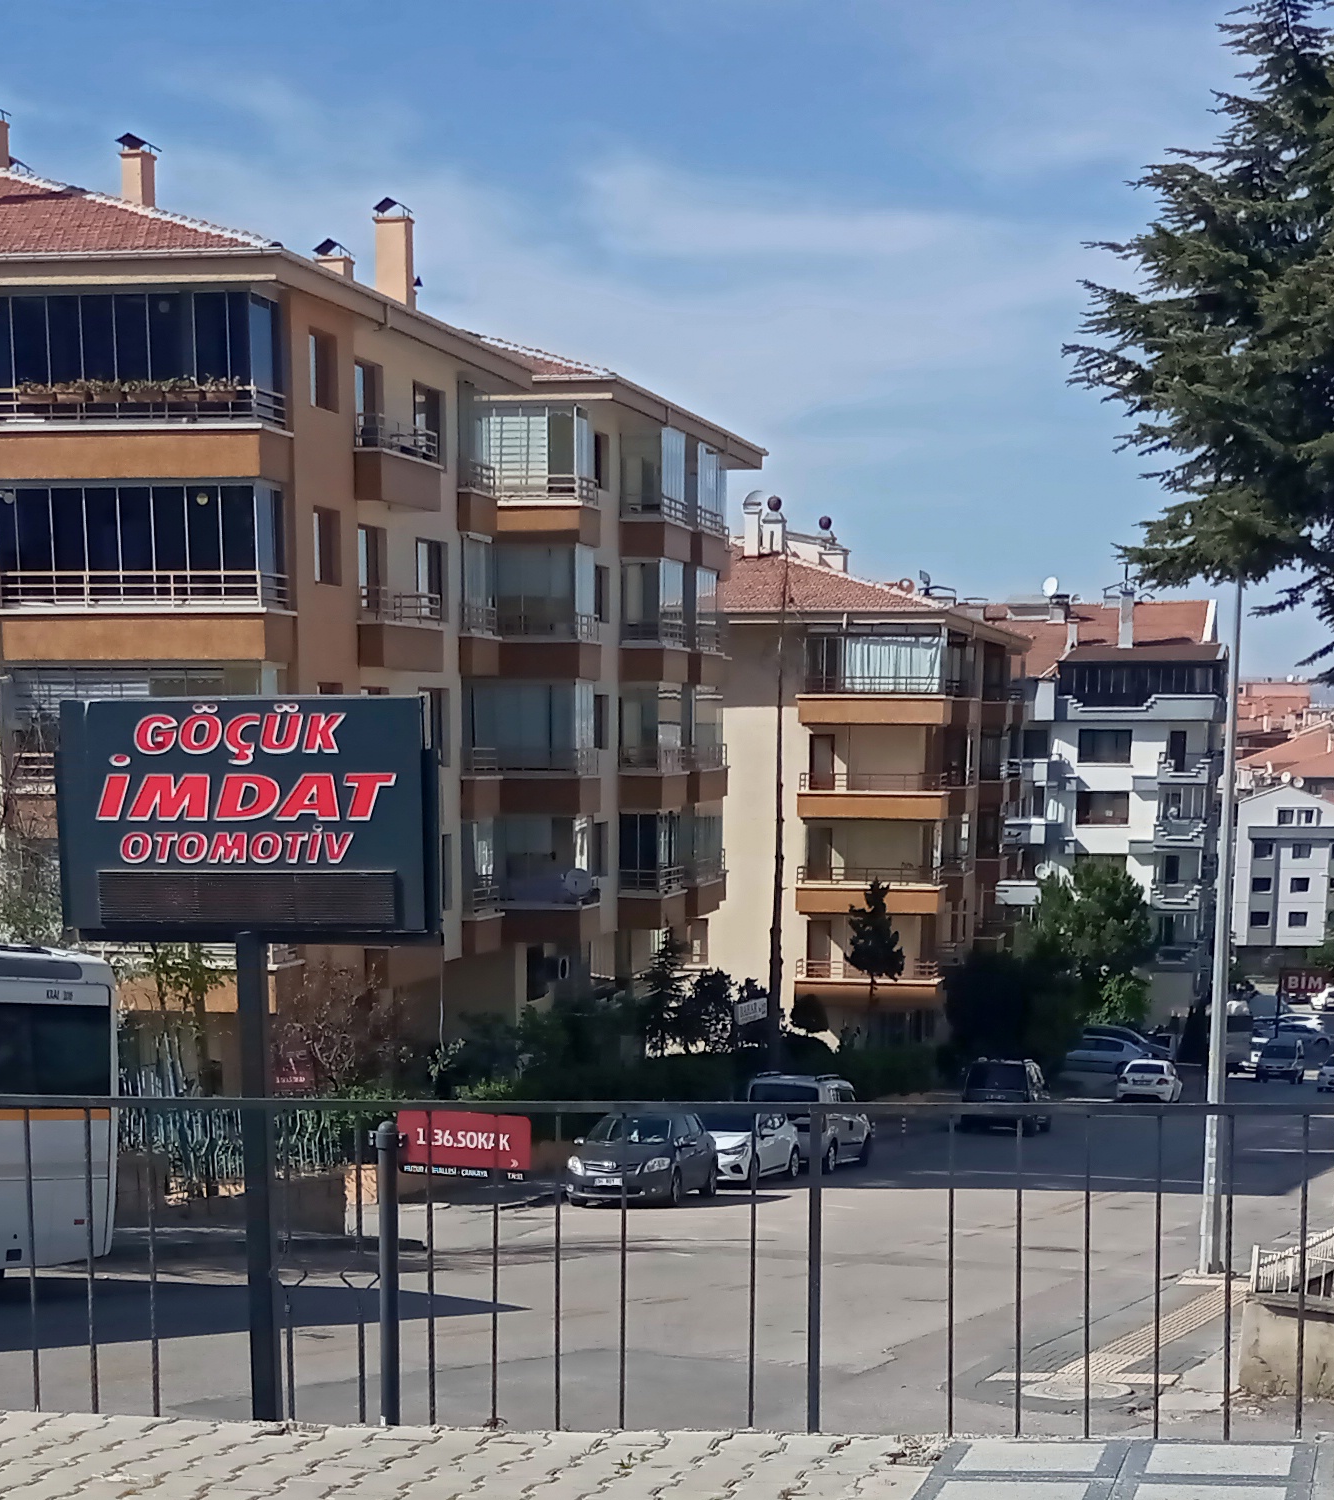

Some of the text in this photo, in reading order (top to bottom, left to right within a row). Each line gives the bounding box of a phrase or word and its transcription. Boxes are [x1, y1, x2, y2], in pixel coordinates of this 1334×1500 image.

[134, 703, 347, 765] GÖÇÜK
[96, 753, 398, 822] İMDAT
[120, 824, 354, 864] OTOMOTİV
[1287, 970, 1323, 990] BİM
